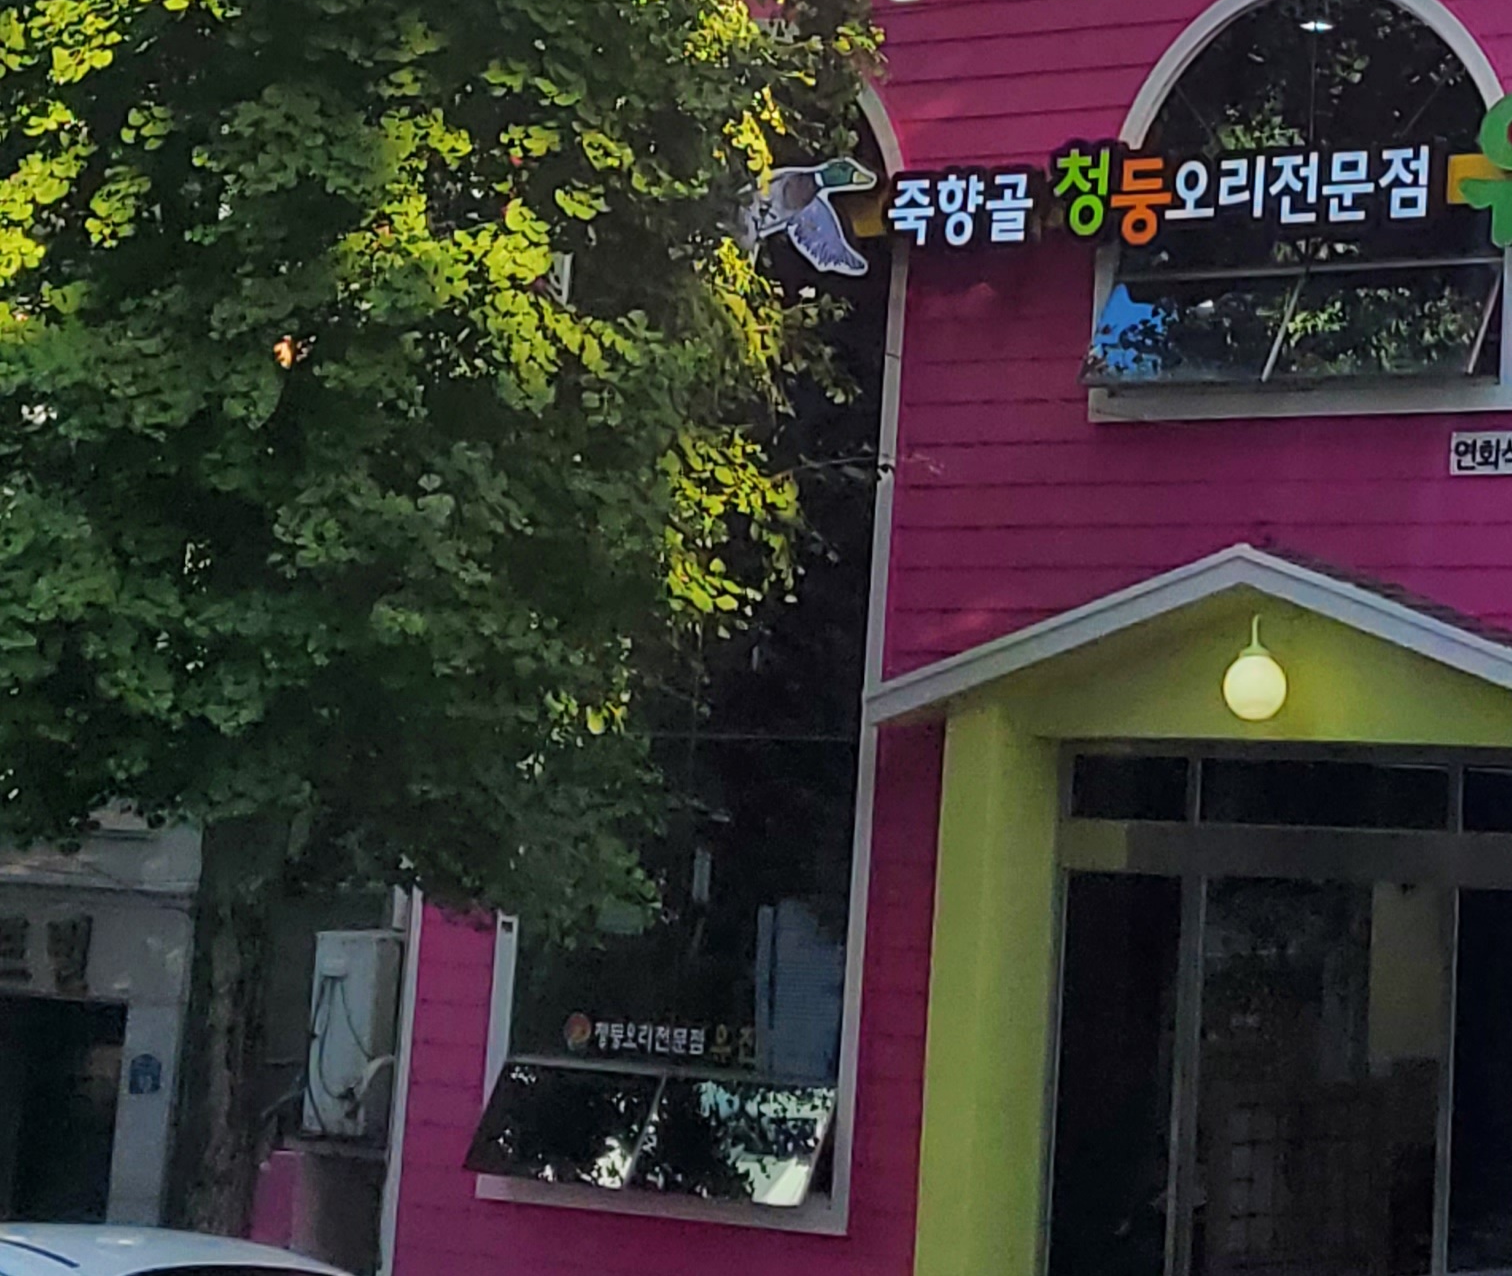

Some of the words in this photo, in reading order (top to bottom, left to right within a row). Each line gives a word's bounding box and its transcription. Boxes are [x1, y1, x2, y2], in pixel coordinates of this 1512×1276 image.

[888, 173, 1033, 245] 죽향골
[1053, 145, 1430, 246] 청둥오리전문점
[708, 1022, 758, 1065] 유진
